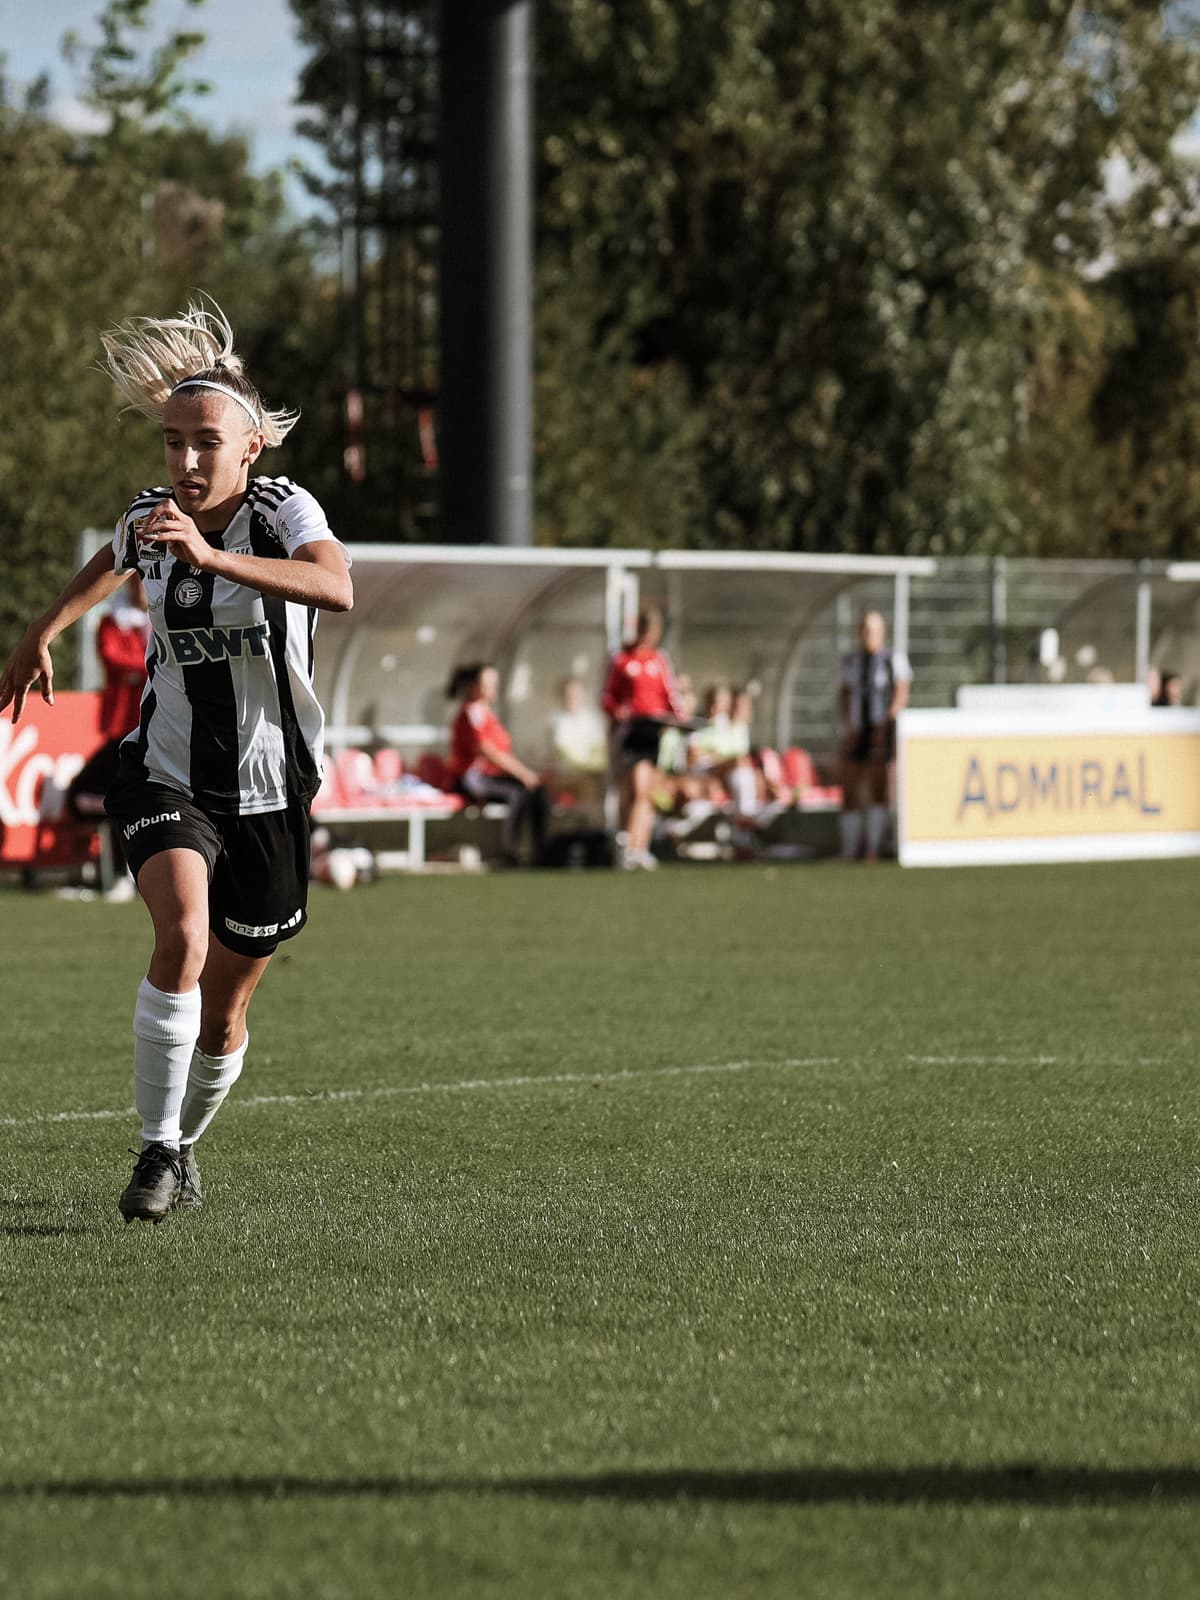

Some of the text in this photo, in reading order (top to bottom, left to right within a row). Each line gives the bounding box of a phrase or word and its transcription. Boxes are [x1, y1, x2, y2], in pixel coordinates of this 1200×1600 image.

[167, 621, 270, 665] BWT
[956, 752, 1163, 821] ADMIRAL
[123, 810, 181, 840] Verbund
